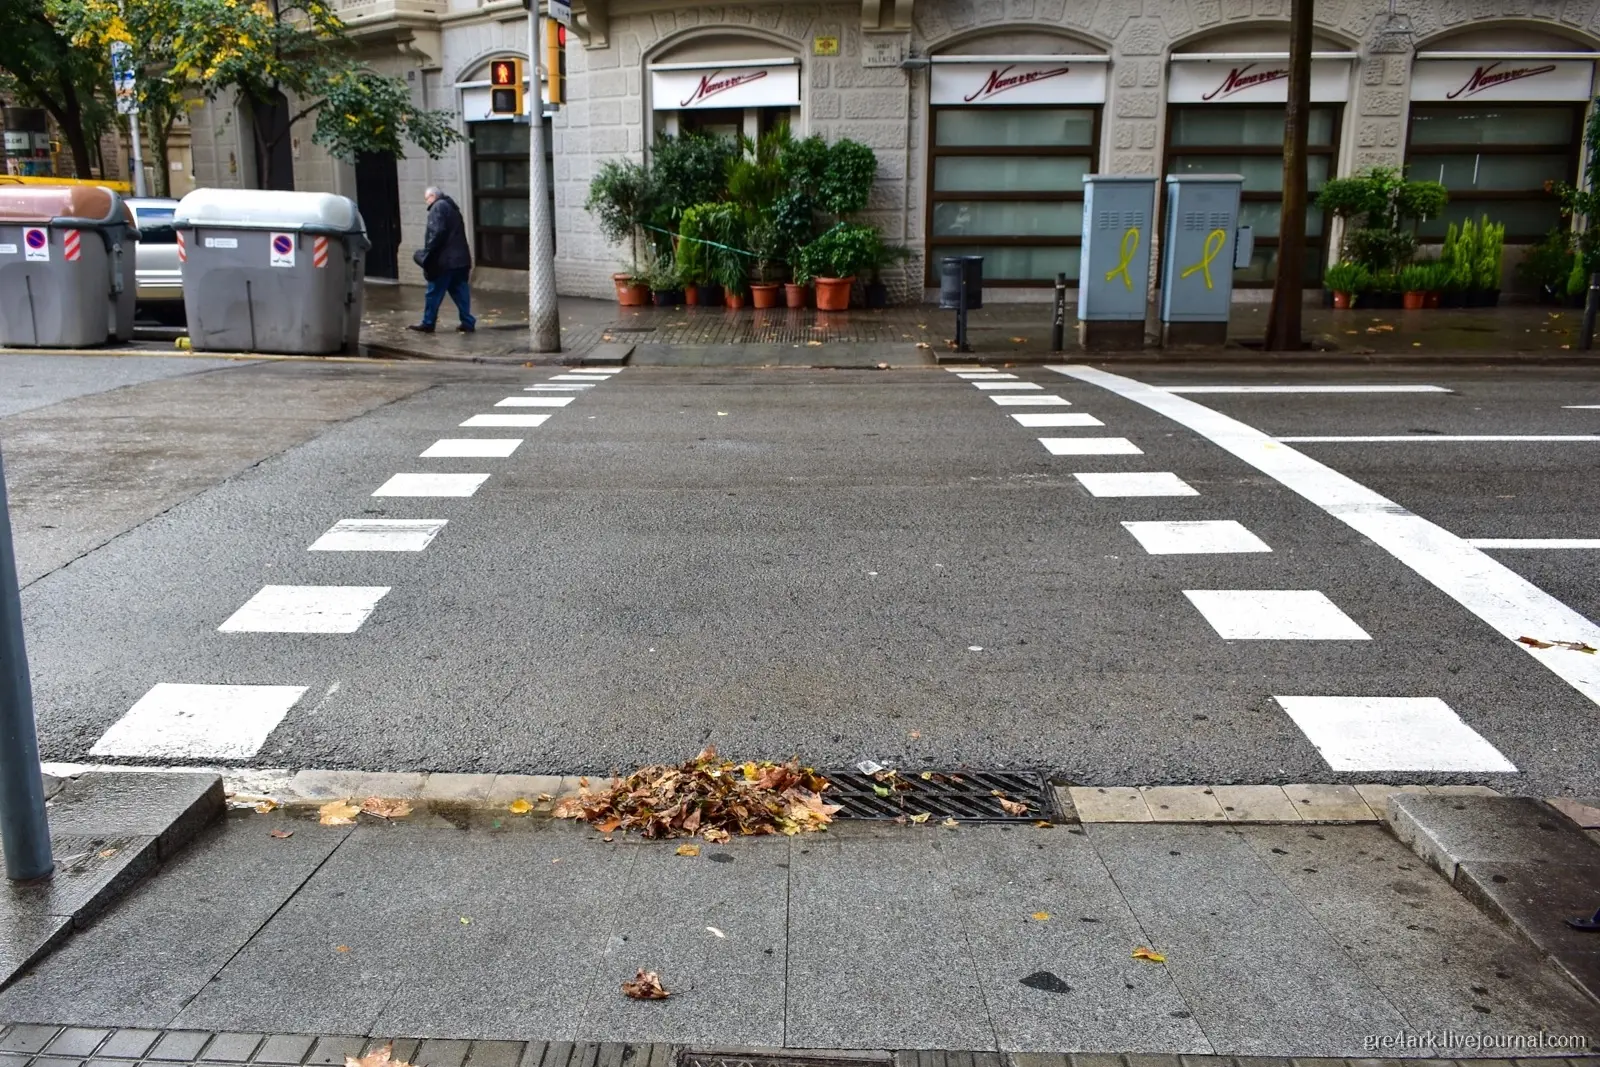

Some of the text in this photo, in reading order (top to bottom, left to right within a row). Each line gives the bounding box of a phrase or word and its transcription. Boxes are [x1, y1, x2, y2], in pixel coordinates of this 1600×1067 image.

[680, 69, 768, 107] Navarro
[963, 64, 1069, 102] Navarro
[1202, 62, 1289, 100] Navarro
[1446, 60, 1557, 99] Navarro
